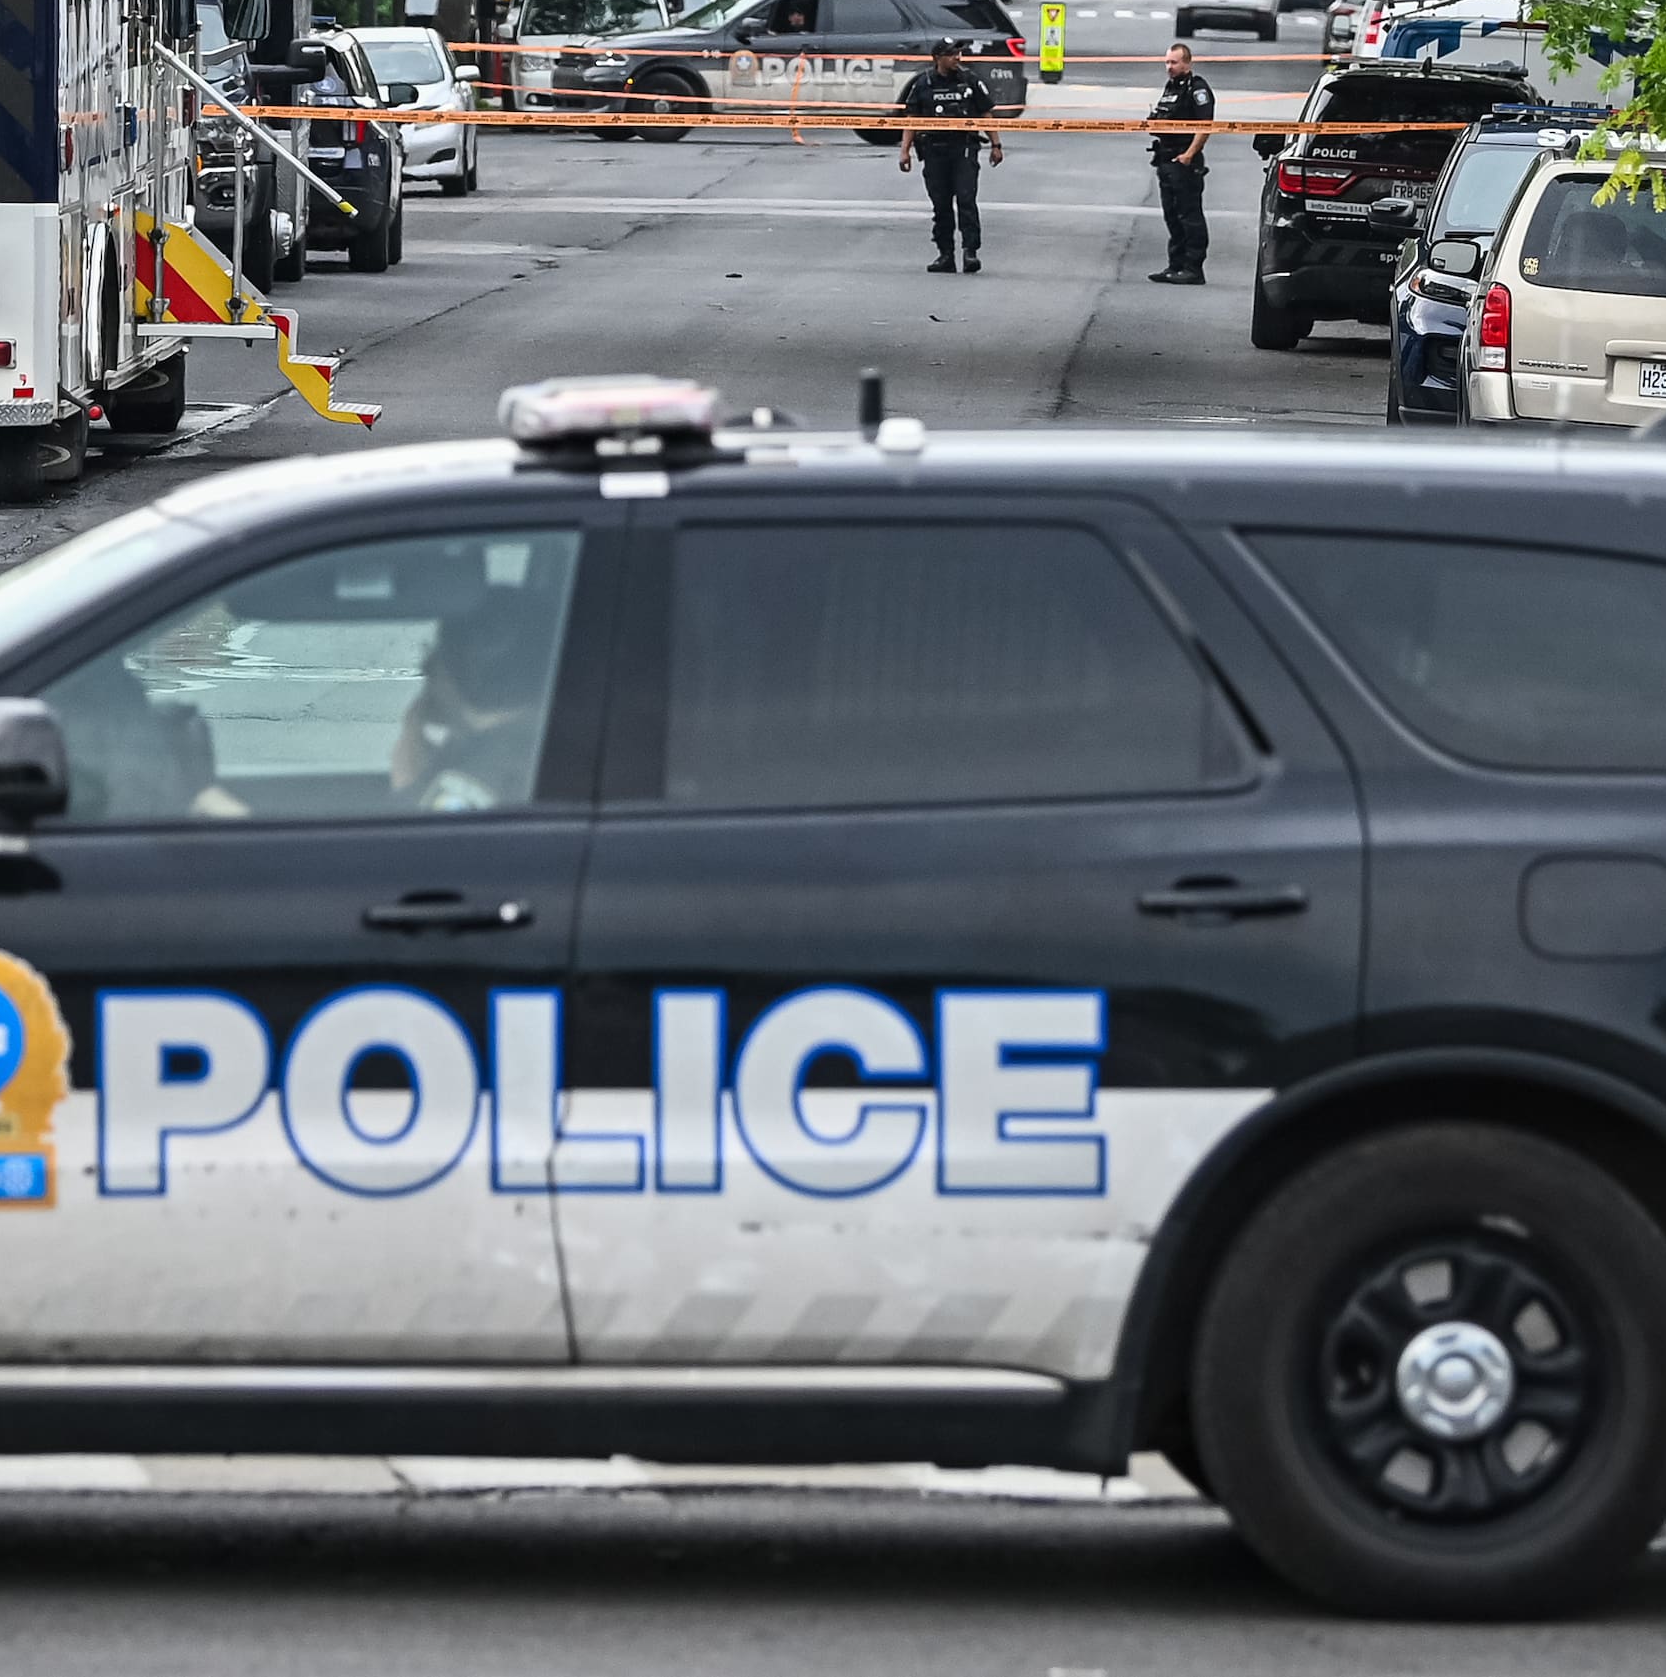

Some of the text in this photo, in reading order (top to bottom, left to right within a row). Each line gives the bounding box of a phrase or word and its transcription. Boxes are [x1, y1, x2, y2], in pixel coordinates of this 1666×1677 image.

[761, 57, 895, 85] POLICE
[1312, 148, 1358, 159] POLICE
[95, 987, 1108, 1198] POLICE
